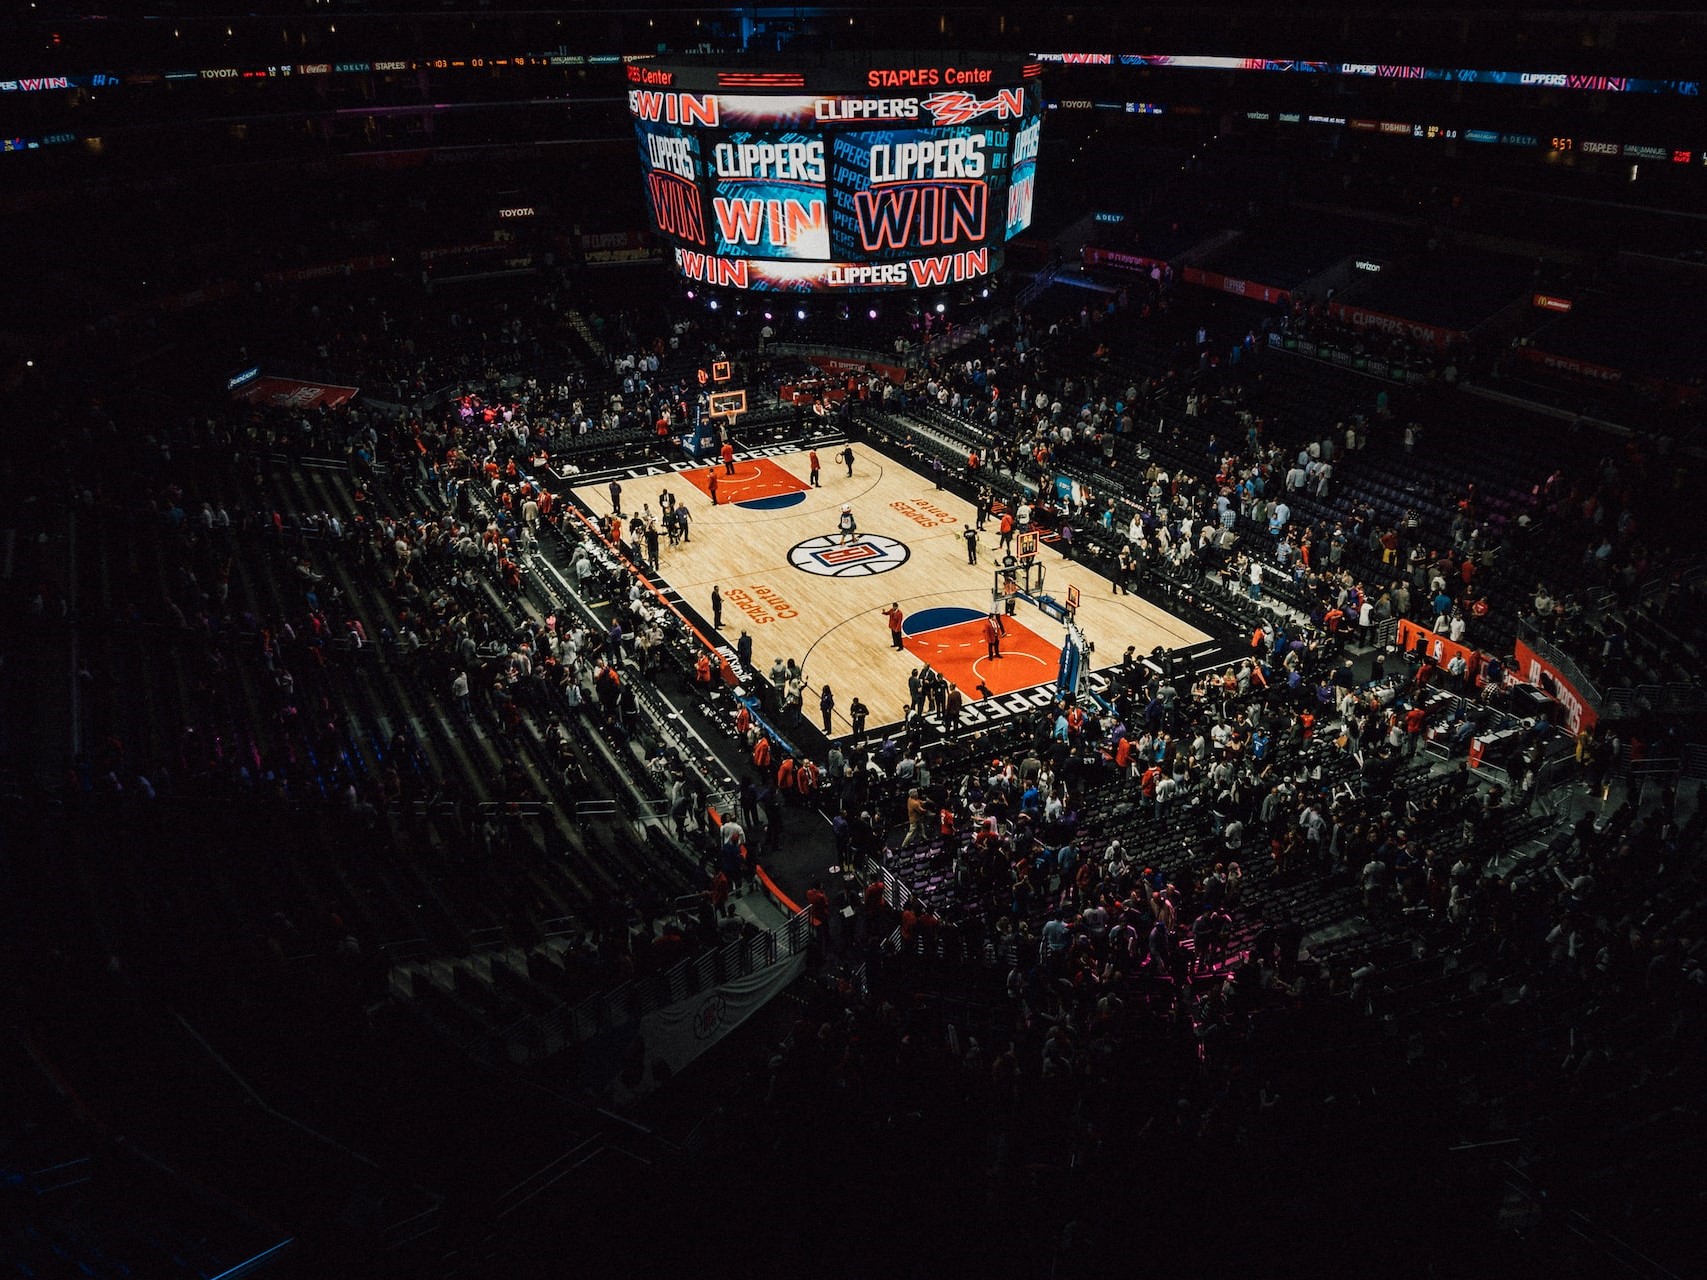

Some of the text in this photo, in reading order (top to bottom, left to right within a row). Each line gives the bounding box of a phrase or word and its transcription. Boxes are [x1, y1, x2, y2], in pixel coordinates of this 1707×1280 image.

[200, 69, 238, 78] TOYOTA
[375, 62, 406, 70] STAPLES
[641, 67, 672, 85] Center
[1342, 63, 1424, 79] CLIPPERS WIN
[19, 77, 68, 91] WIN
[868, 69, 993, 87] STAPLES Center
[1521, 73, 1626, 91] CLIPPERS WIN
[636, 89, 719, 127] WIN
[815, 97, 919, 120] CLIPPERS
[1061, 101, 1093, 109] TOYOTA
[1380, 123, 1412, 132] TOSHIBA
[1511, 136, 1537, 145] DELTA
[1583, 142, 1618, 154] STAPLES
[648, 133, 695, 181] CLIPPERS
[715, 141, 826, 182] CLIPPERS
[870, 134, 987, 183] CLIPPERS
[499, 208, 534, 217] TOYOTA
[648, 173, 706, 246] WIN
[854, 182, 987, 251] WIN
[713, 197, 826, 246] WIN
[681, 248, 748, 289] WIN
[828, 247, 988, 287] CLIPPERS WIN
[1355, 260, 1381, 272] verizon
[629, 466, 665, 478] LA
[889, 500, 939, 529] STAPLES
[910, 498, 958, 524] Center
[724, 588, 775, 625] STAPLES
[750, 584, 799, 619] Center
